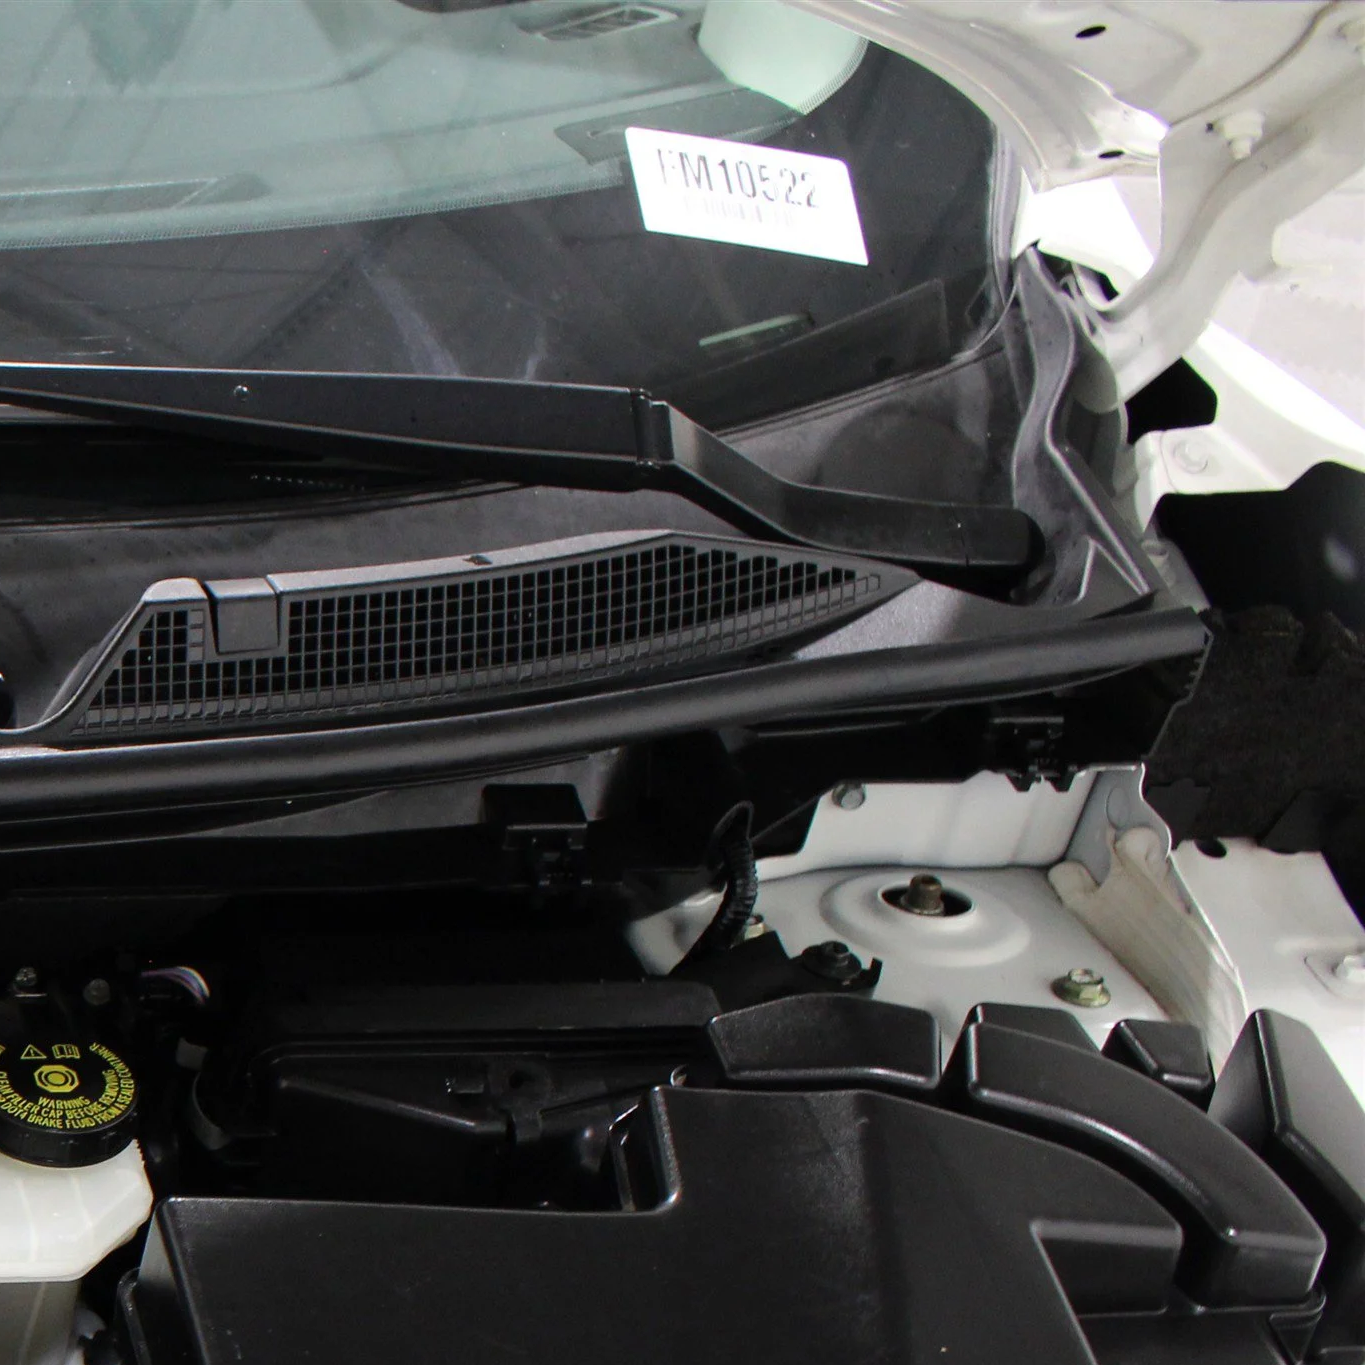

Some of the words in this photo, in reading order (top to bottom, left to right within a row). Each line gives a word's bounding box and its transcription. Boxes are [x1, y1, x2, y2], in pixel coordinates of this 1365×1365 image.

[89, 1042, 132, 1078] CONTAINER
[6, 1092, 40, 1115] FILLER
[41, 1107, 63, 1119] CAP
[65, 1101, 107, 1119] BEFORE
[98, 1069, 119, 1106] REMOVING
[116, 1078, 135, 1104] SEALED
[38, 1096, 91, 1109] WARNING
[27, 1114, 63, 1129] BRAKE
[65, 1117, 96, 1129] FLUID
[93, 1106, 122, 1124] FROM
